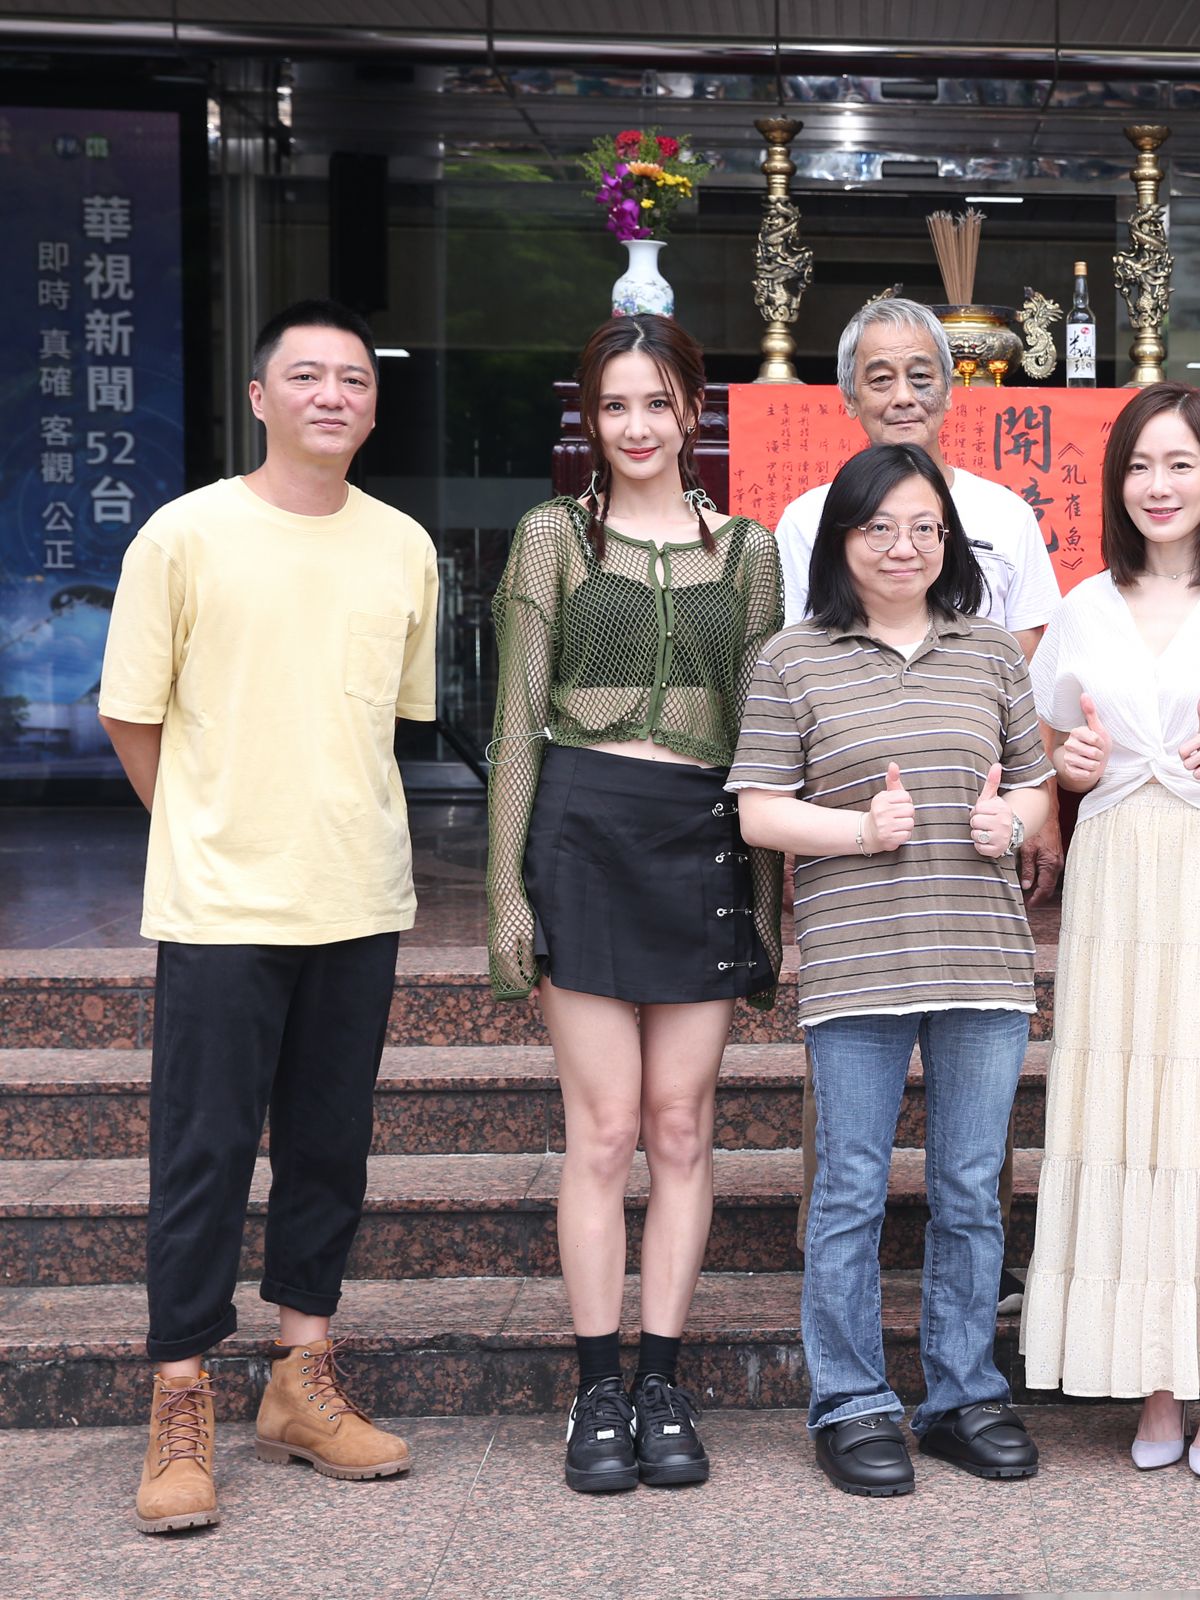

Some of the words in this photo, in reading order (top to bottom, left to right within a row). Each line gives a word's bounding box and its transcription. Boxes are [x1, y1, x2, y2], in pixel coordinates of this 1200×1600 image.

[38, 241, 70, 310] 即時
[39, 329, 72, 398] 真確
[83, 196, 136, 525] 華視新聞52台
[40, 415, 74, 484] 客觀
[42, 500, 75, 569] 公正
